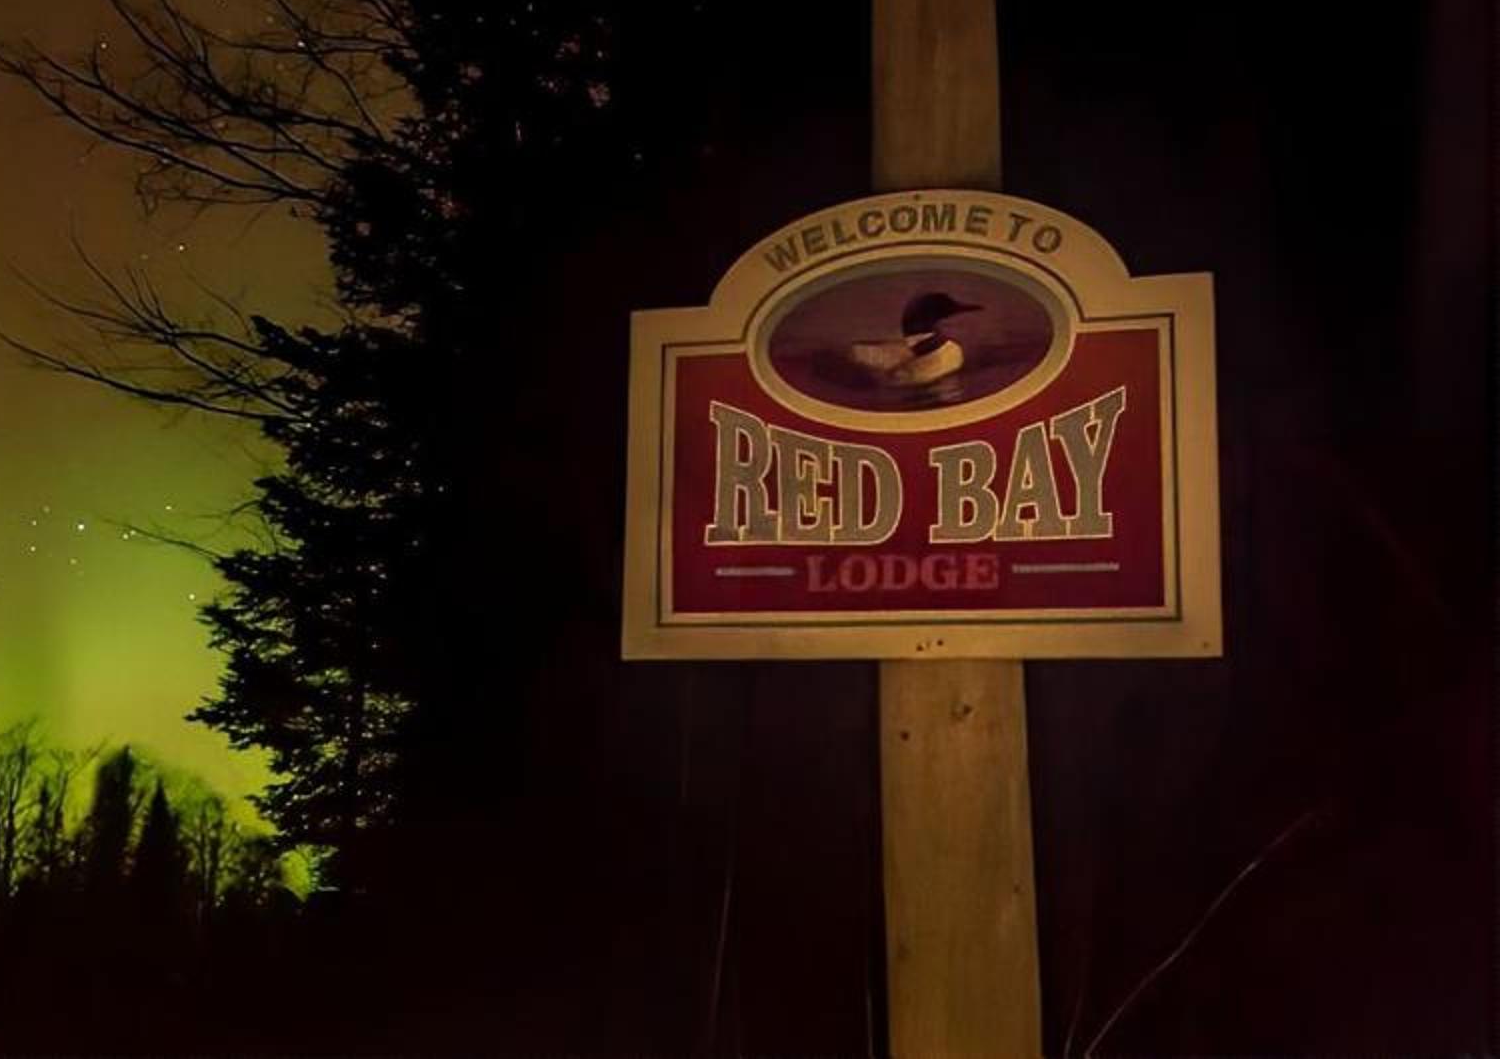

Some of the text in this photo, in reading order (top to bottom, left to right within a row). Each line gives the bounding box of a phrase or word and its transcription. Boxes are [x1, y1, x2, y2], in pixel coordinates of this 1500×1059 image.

[764, 204, 1062, 272] WELCOME TO
[705, 385, 1126, 545] RED BAY
[807, 553, 999, 591] LODGE
